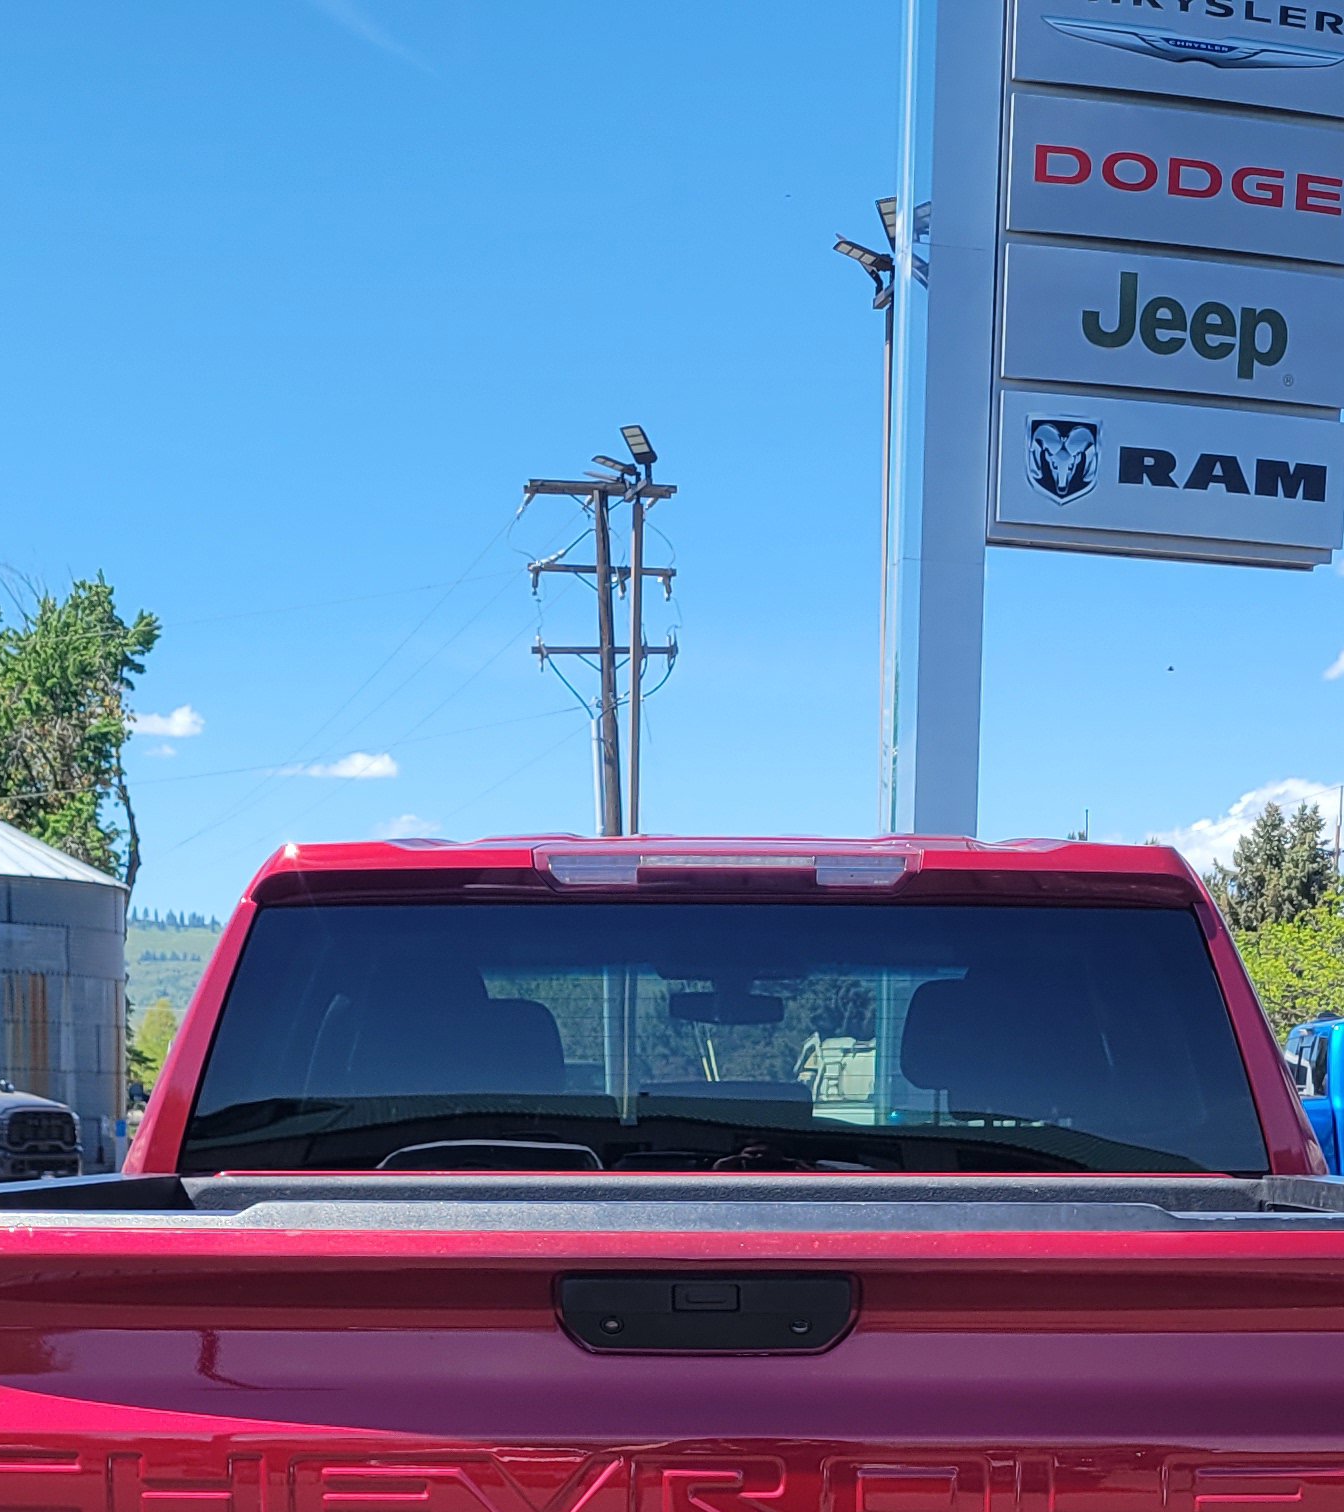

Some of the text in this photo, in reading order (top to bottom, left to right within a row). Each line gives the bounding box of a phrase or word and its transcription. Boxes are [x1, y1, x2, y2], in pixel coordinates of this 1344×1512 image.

[1034, 144, 1344, 216] DODGE
[1081, 271, 1289, 380] Jeep
[1118, 445, 1328, 502] RAM
